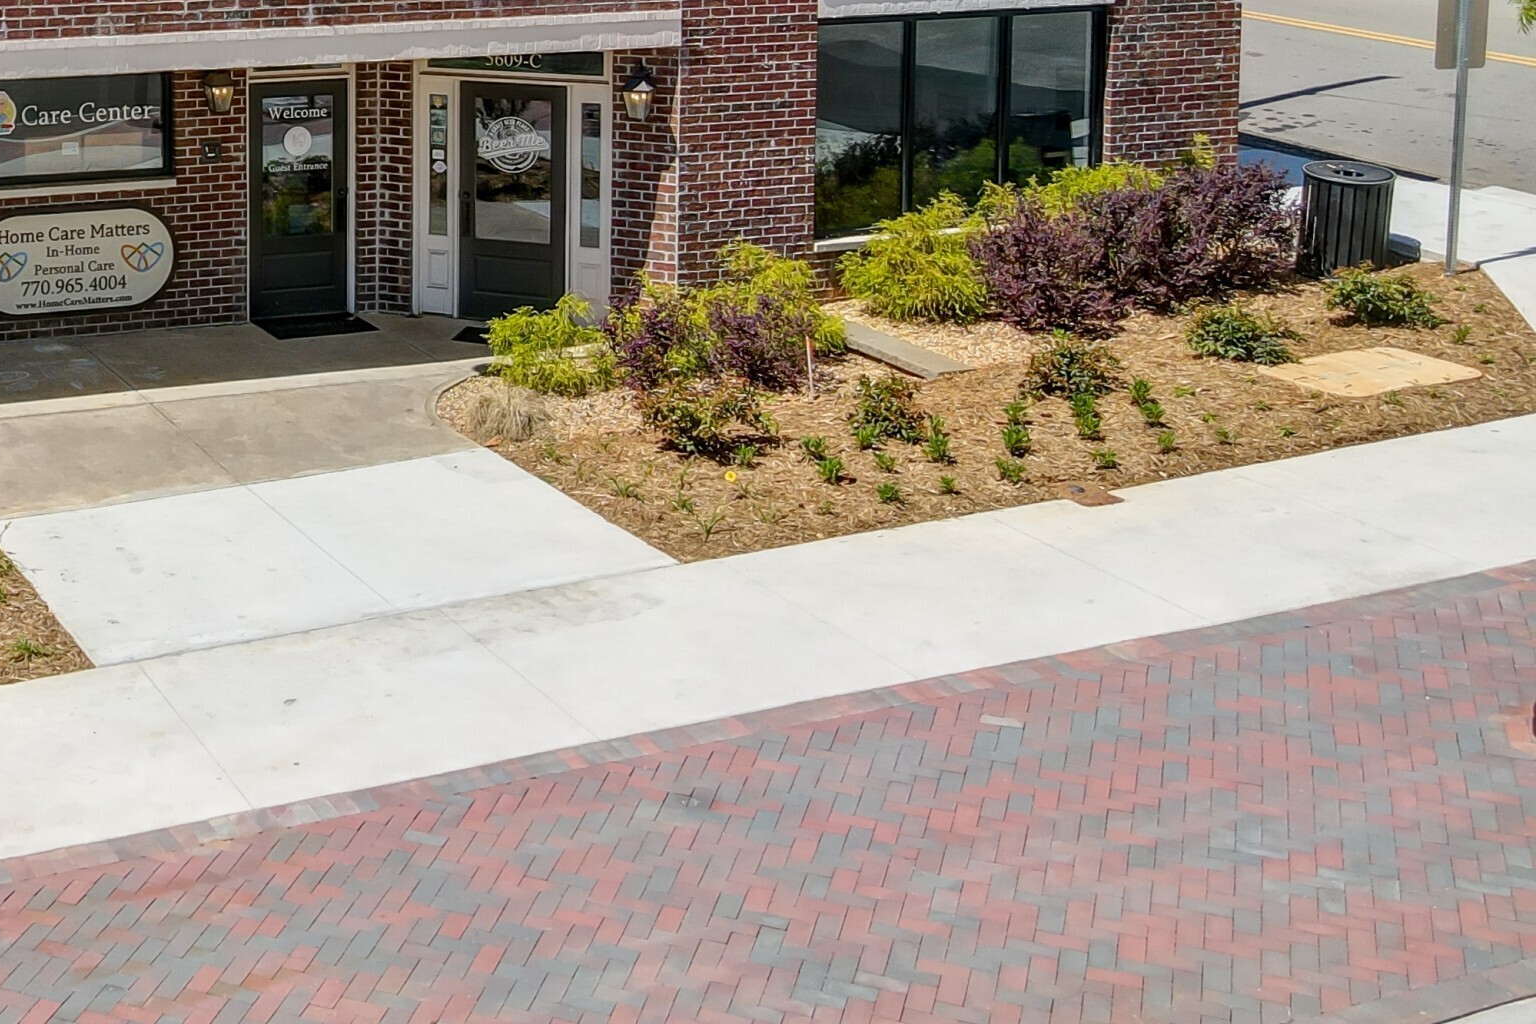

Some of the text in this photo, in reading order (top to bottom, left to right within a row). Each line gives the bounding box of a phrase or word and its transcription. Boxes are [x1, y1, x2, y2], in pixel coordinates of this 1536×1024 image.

[21, 102, 154, 127] Care Center
[268, 106, 328, 120] Welcome
[479, 133, 545, 152] Beer Me
[268, 161, 329, 173] Guest Entrance
[48, 225, 85, 241] Care
[90, 223, 151, 238] Matters
[46, 244, 100, 258] In-Home
[34, 260, 115, 276] Personal Care
[21, 274, 127, 297] 770.965.4004
[15, 295, 133, 310] www.HomeCareMatters.com
